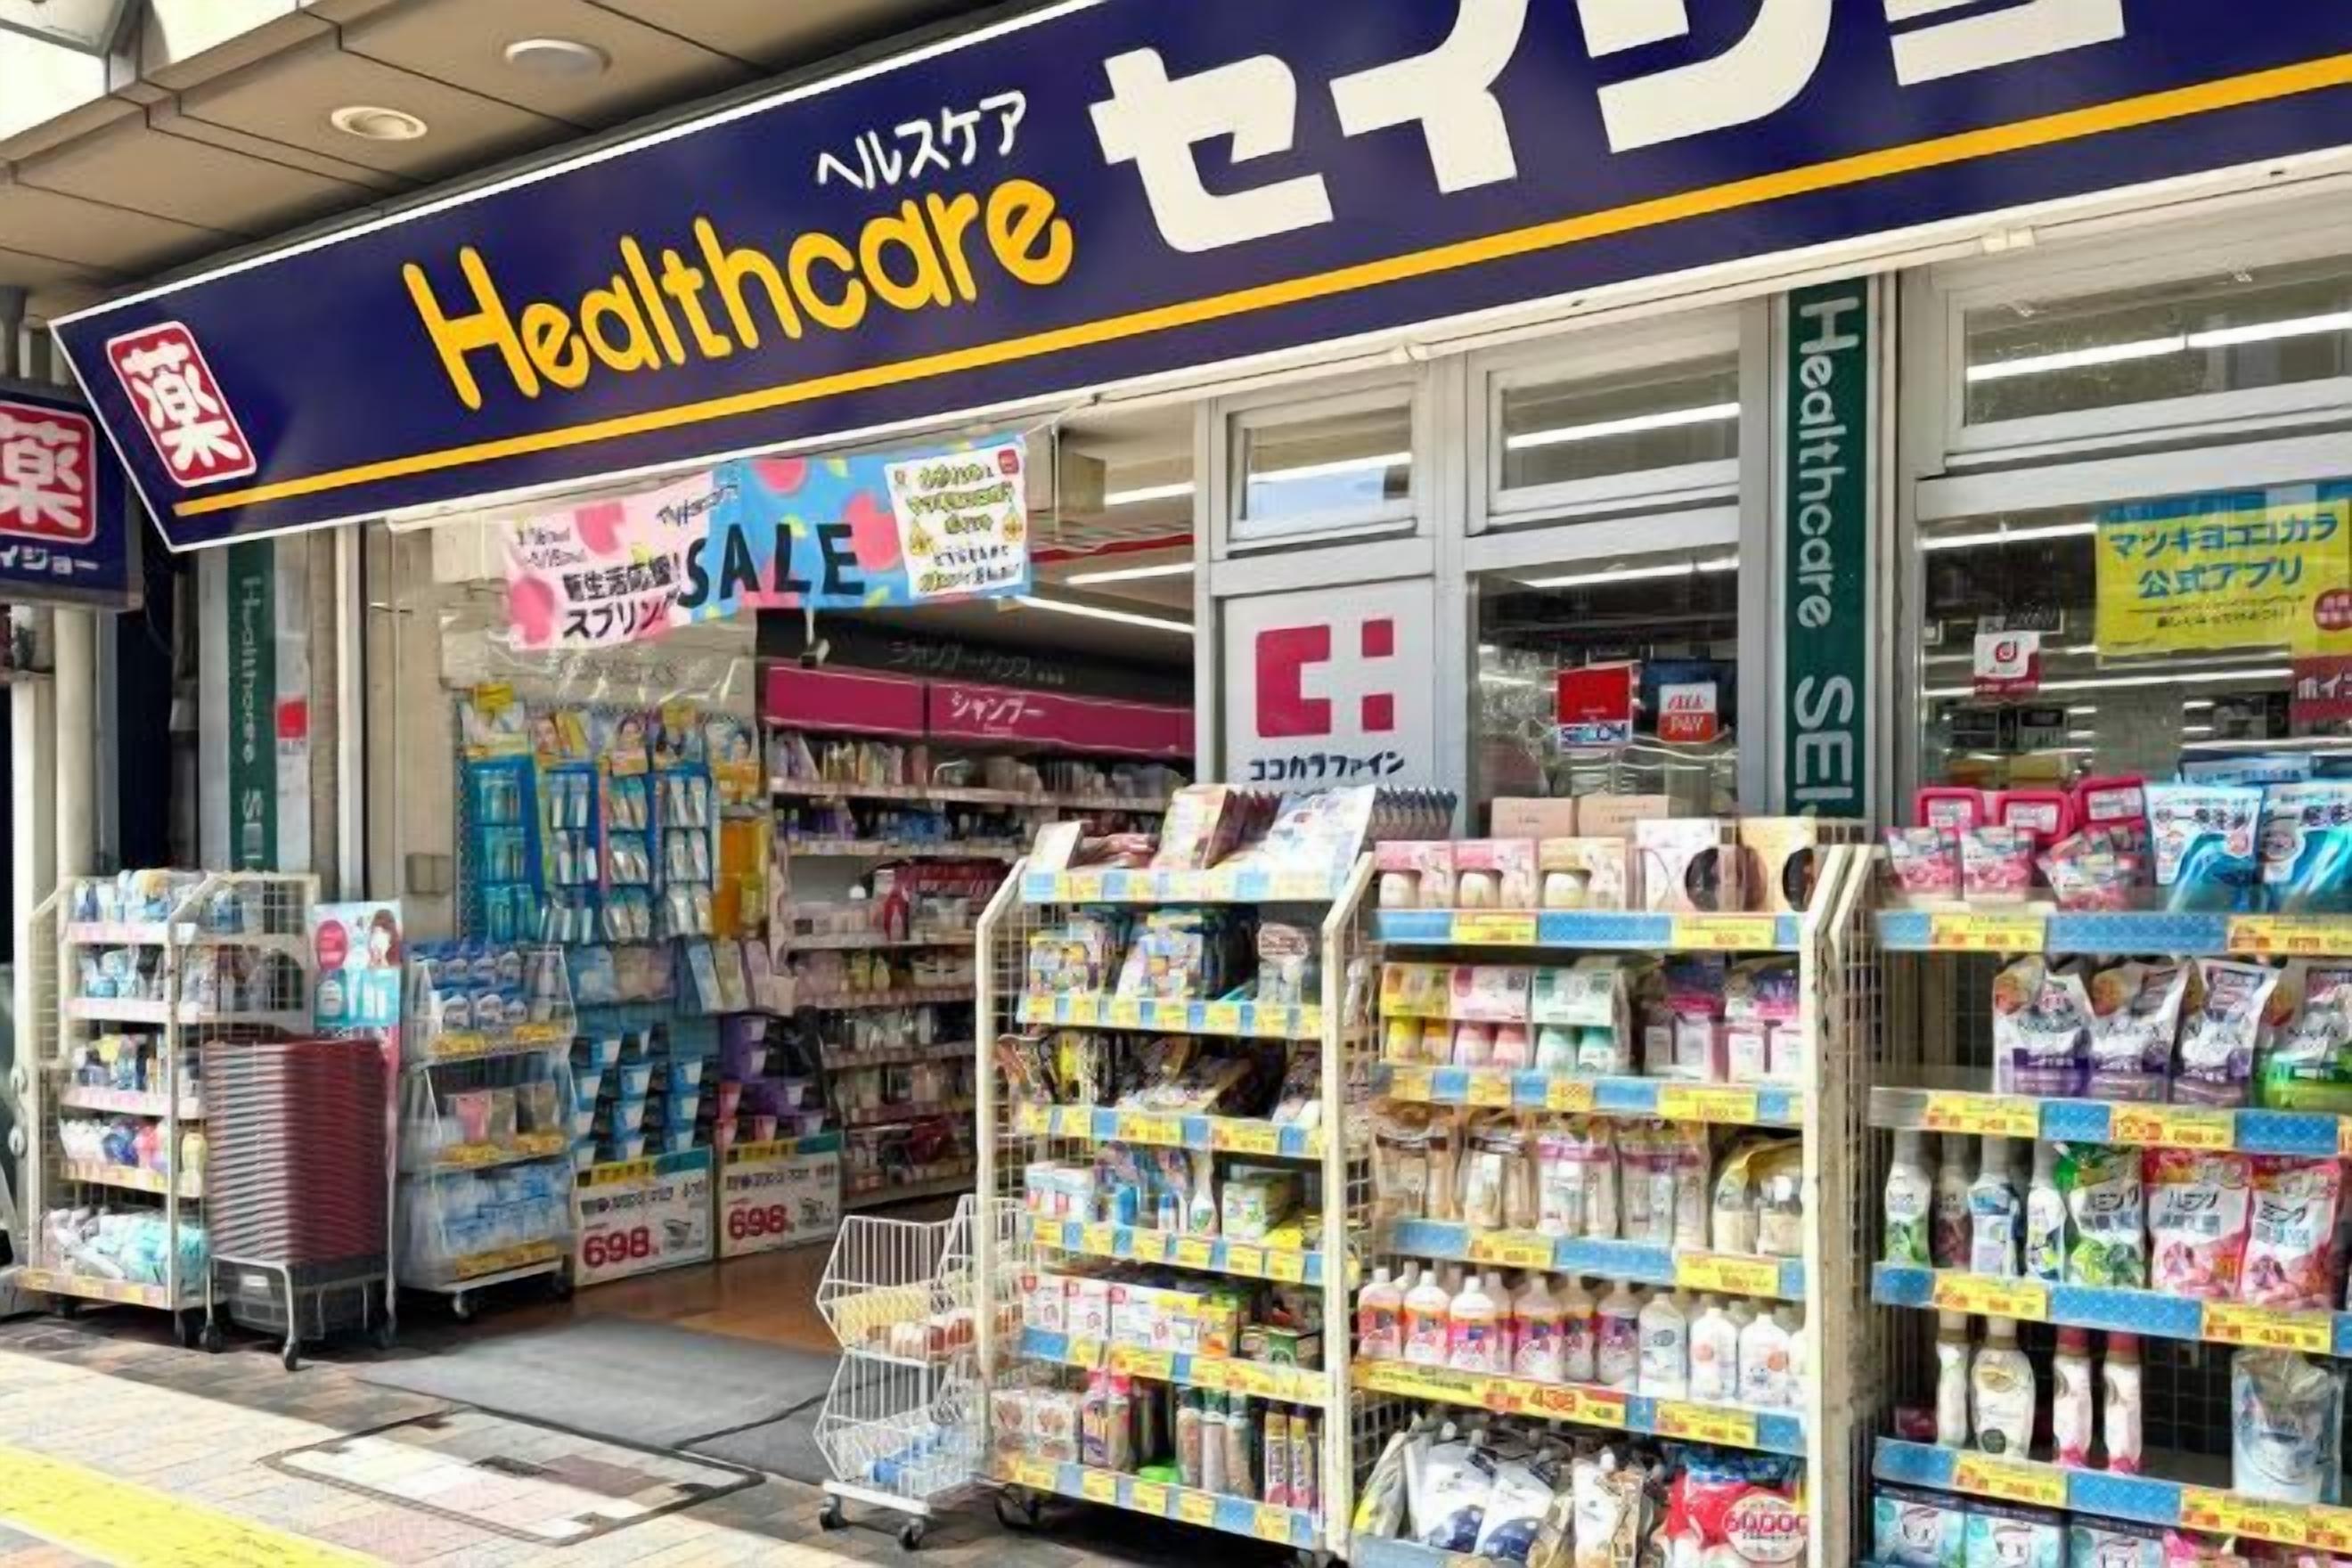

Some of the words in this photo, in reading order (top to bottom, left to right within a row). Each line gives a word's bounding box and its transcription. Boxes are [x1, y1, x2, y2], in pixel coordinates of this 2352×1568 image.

[816, 90, 1026, 190] ヘルスケア
[404, 178, 1074, 410] Healthcare
[122, 341, 241, 470] 薬
[1794, 297, 1860, 628] Healthcare
[678, 522, 866, 609] SALE
[2110, 515, 2339, 559] マツキヨココカラ
[2139, 556, 2302, 599] 公式アプリ
[241, 576, 261, 764] Healthcare
[1249, 752, 1406, 782] ココカラファイン
[583, 1226, 650, 1269] 698
